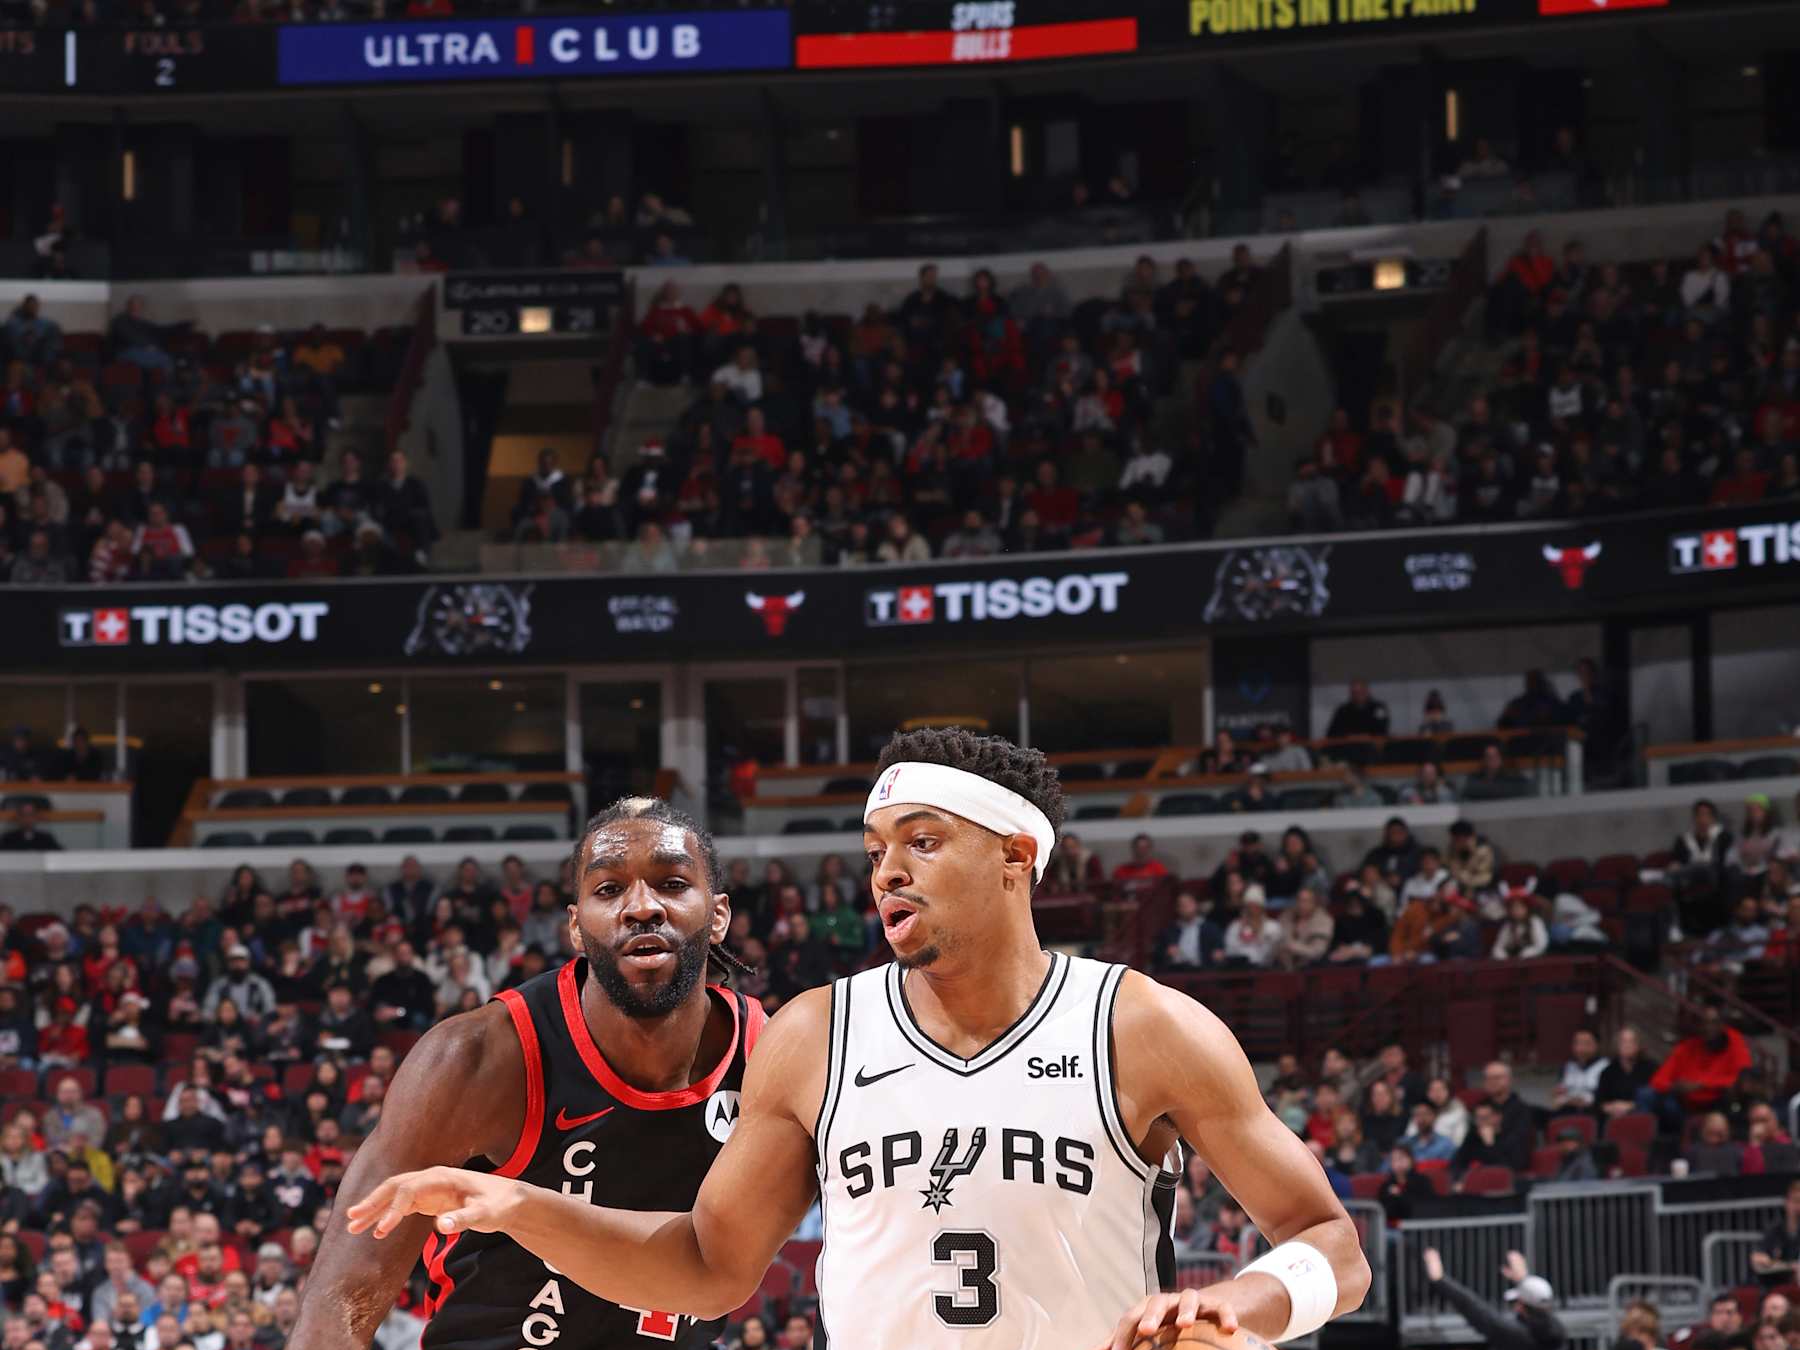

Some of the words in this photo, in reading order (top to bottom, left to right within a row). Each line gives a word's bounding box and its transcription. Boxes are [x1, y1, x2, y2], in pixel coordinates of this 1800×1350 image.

[364, 33, 500, 68] ULTRA
[550, 24, 702, 63] CLUB
[154, 57, 176, 86] 2
[934, 571, 1129, 622] TISSOT
[130, 602, 329, 645] TISSOT
[1027, 1055, 1083, 1079] Self.
[839, 1127, 1095, 1215] SPURS
[930, 1227, 1001, 1330] 3
